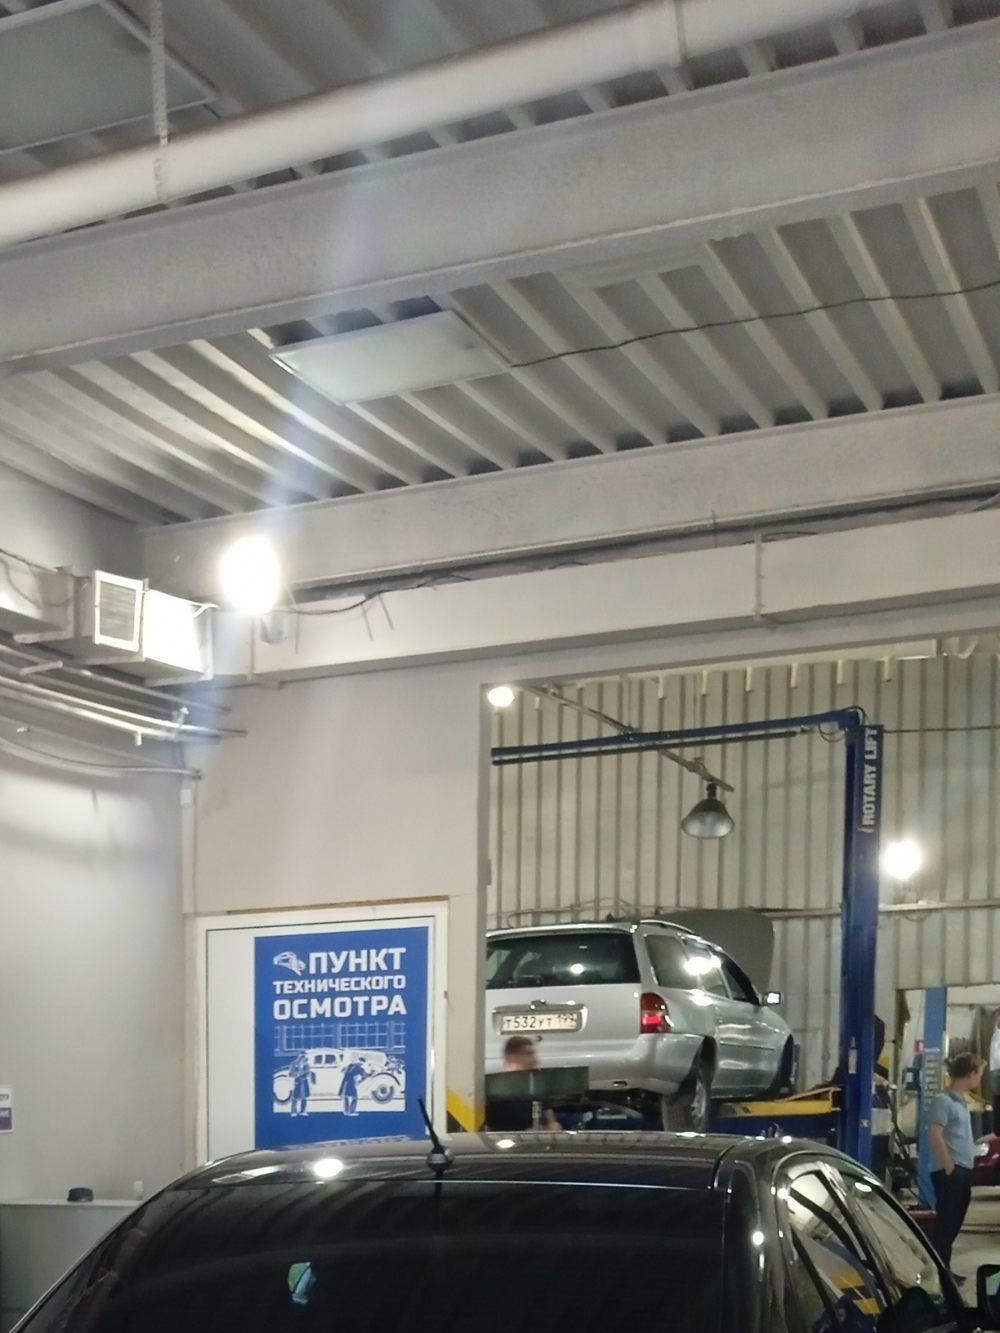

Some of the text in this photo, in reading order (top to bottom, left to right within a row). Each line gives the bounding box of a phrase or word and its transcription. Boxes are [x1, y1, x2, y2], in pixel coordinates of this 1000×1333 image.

[862, 727, 878, 826] ROTARY LIFT
[308, 947, 407, 975] ПУНКТ
[272, 974, 407, 995] ТЕХНИЧЕСКОГО
[272, 994, 408, 1020] ОСМОТРА
